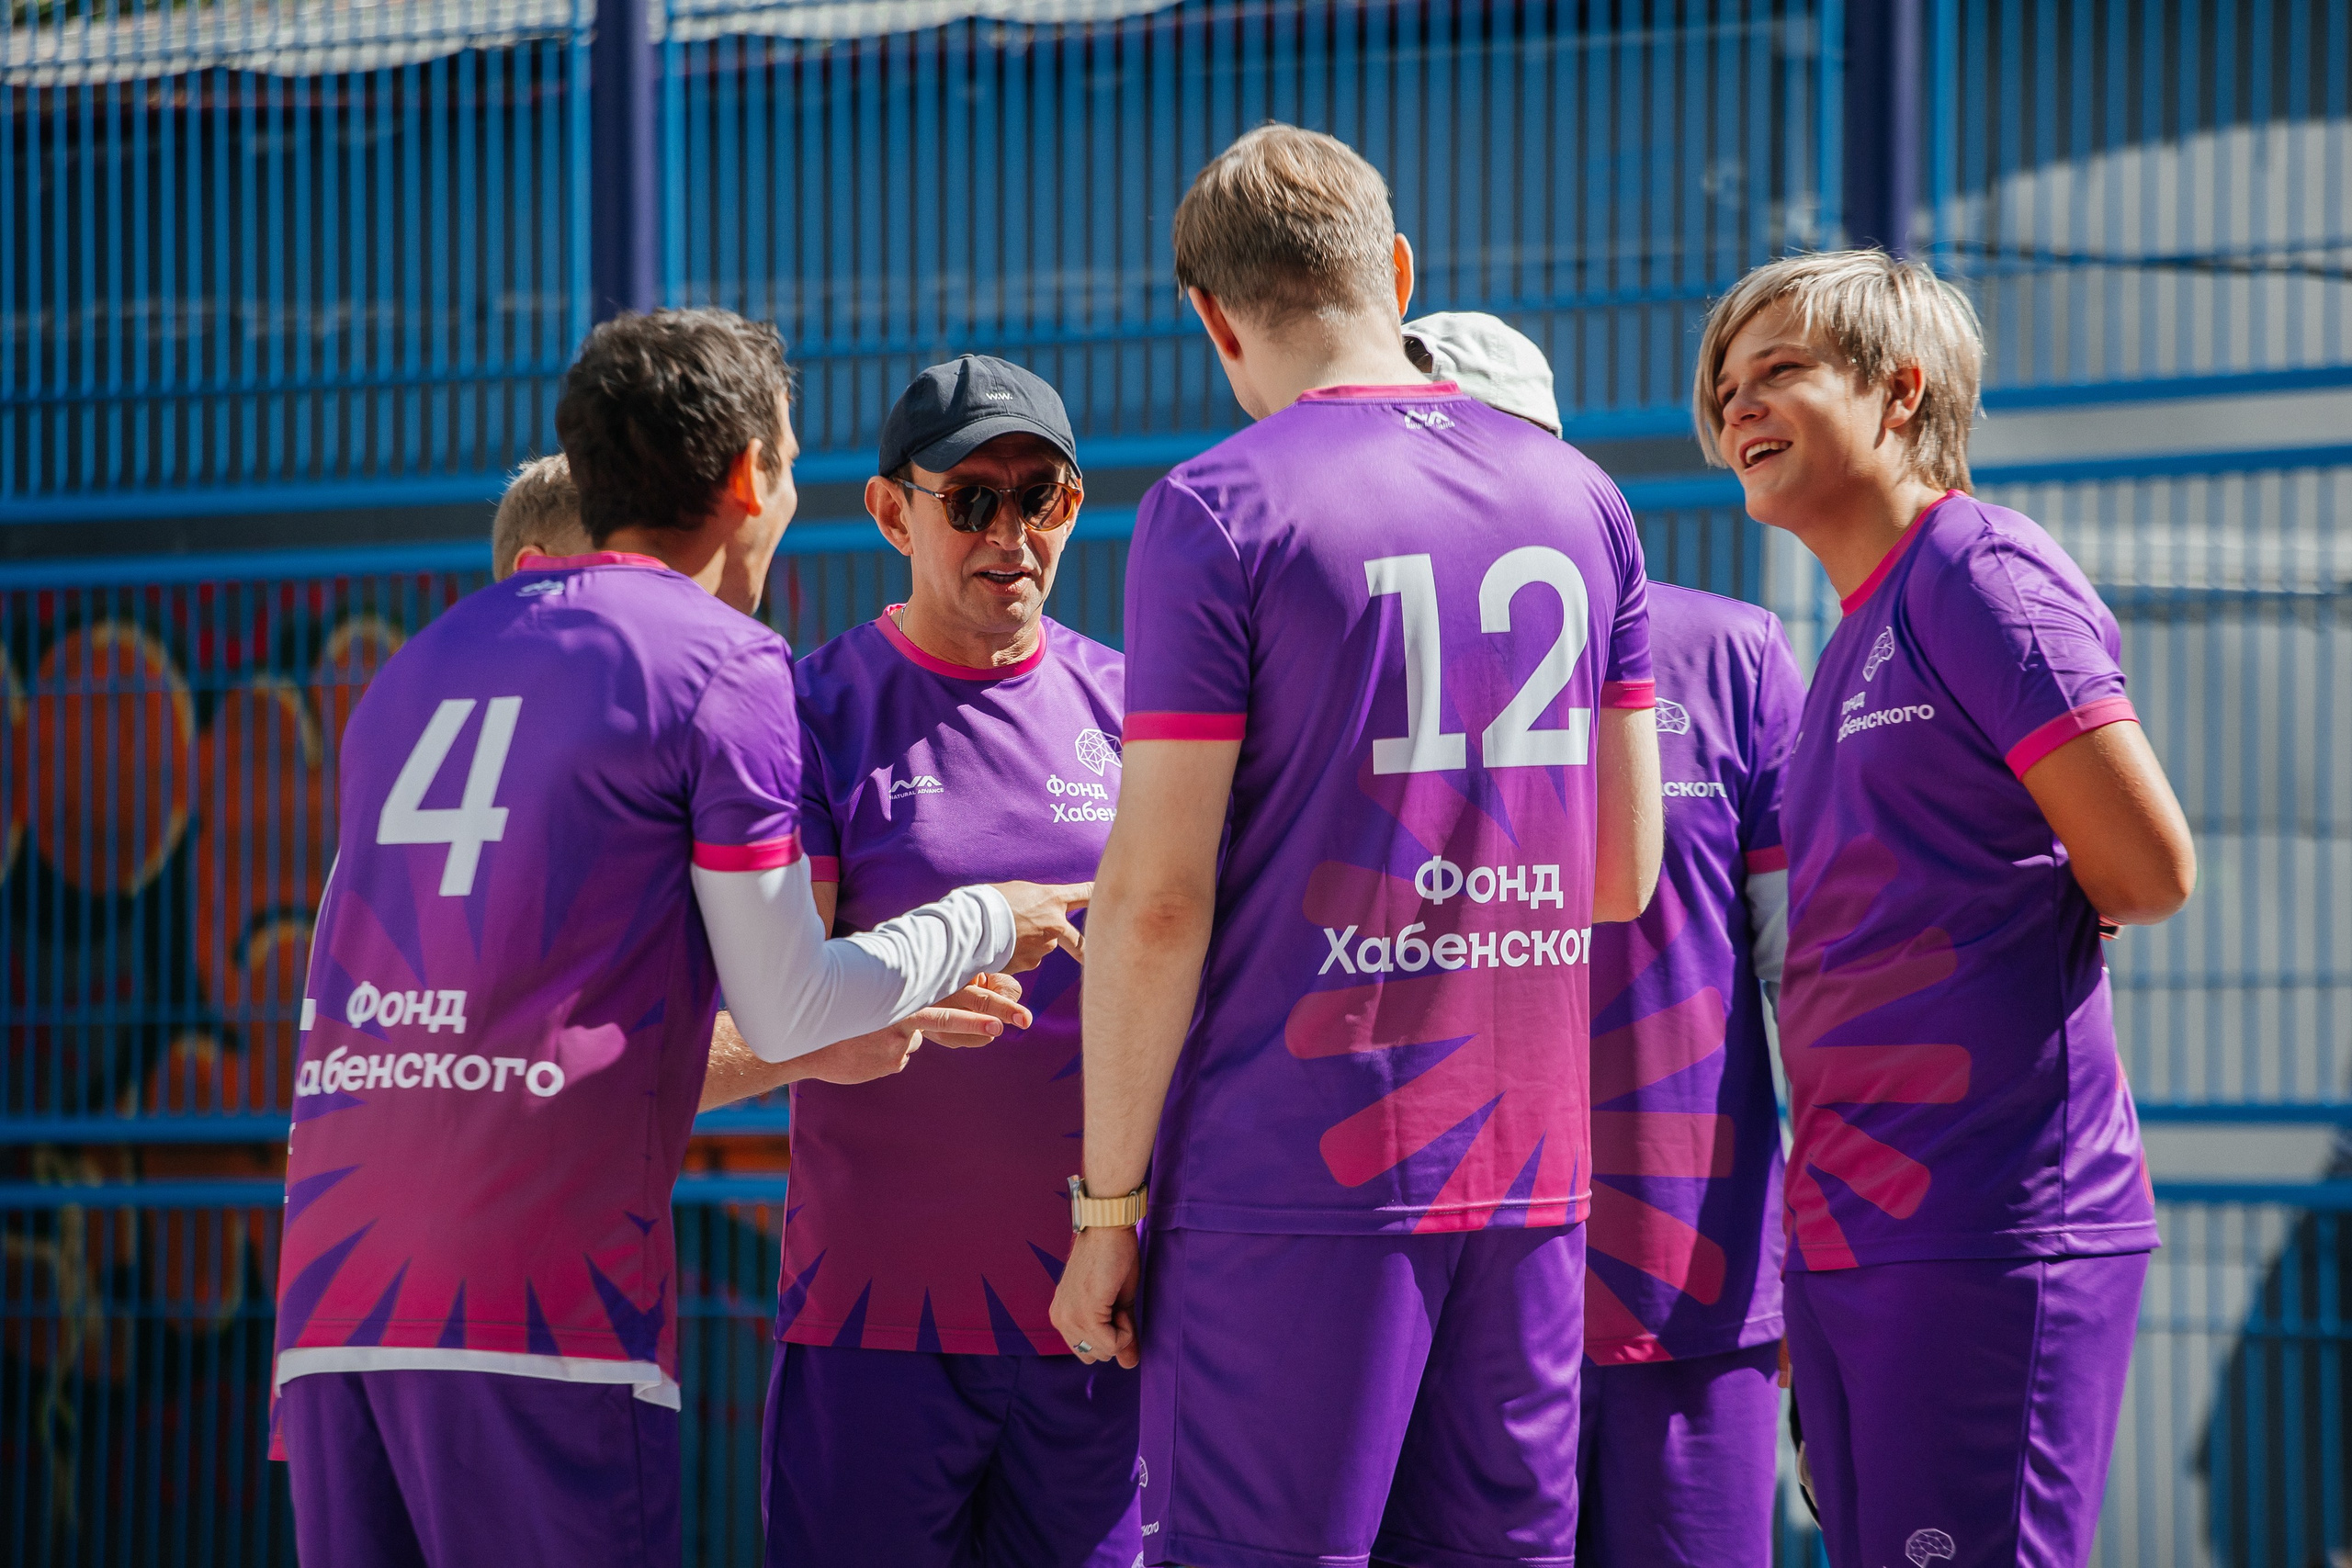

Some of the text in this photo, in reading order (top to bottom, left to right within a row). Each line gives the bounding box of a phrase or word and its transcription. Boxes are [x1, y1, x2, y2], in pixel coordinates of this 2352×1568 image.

[1363, 545, 1590, 774] 12
[376, 695, 523, 897] 4
[888, 790, 917, 800] NATURAL
[1046, 774, 1109, 800] Фонд
[1414, 855, 1564, 909] Фонд
[345, 980, 468, 1033] Фонд
[295, 1045, 566, 1097] абенского
